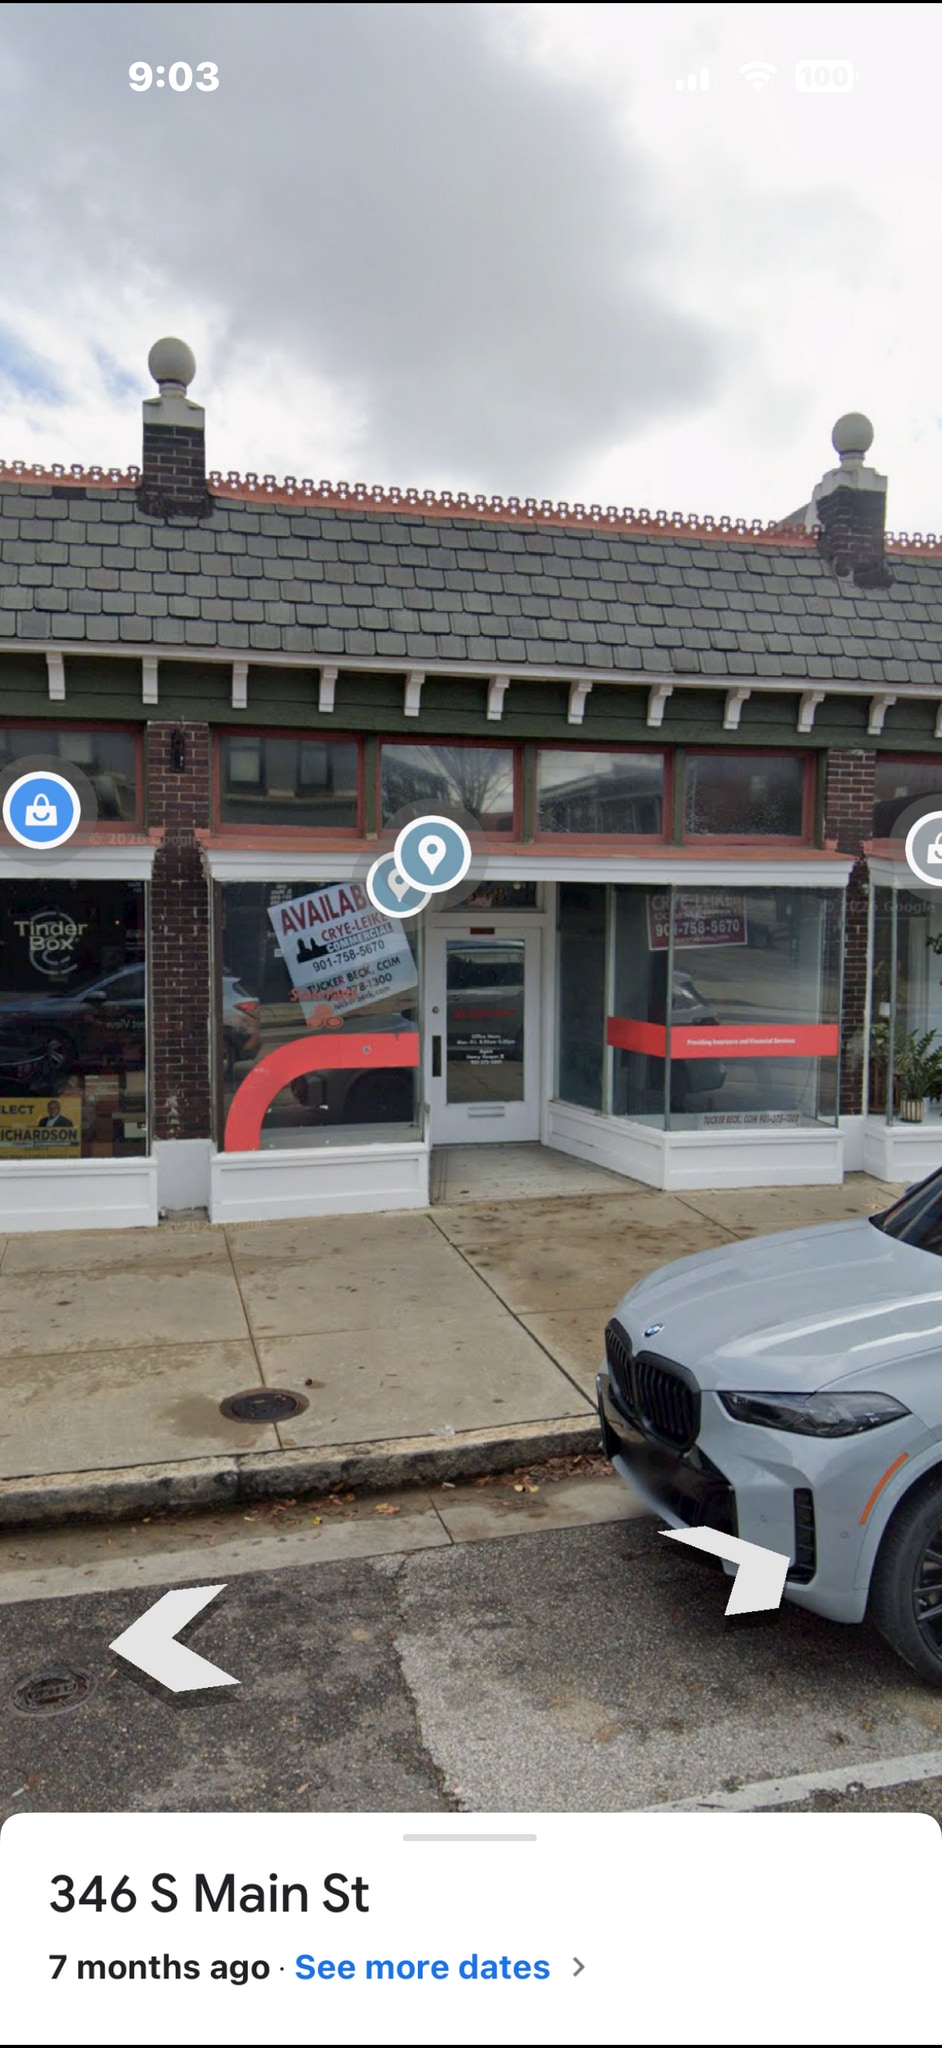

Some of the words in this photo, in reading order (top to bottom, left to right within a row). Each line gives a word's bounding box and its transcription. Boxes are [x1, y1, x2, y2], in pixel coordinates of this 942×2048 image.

[280, 883, 373, 937] AVAILAB
[13, 921, 88, 937] Tinder
[29, 936, 74, 951] Box
[327, 922, 393, 953] COMMERCIAL
[312, 940, 385, 973] 901-758-5670
[306, 975, 346, 996] TUCKER
[347, 966, 375, 983] BECK,
[376, 955, 401, 971] CCIM
